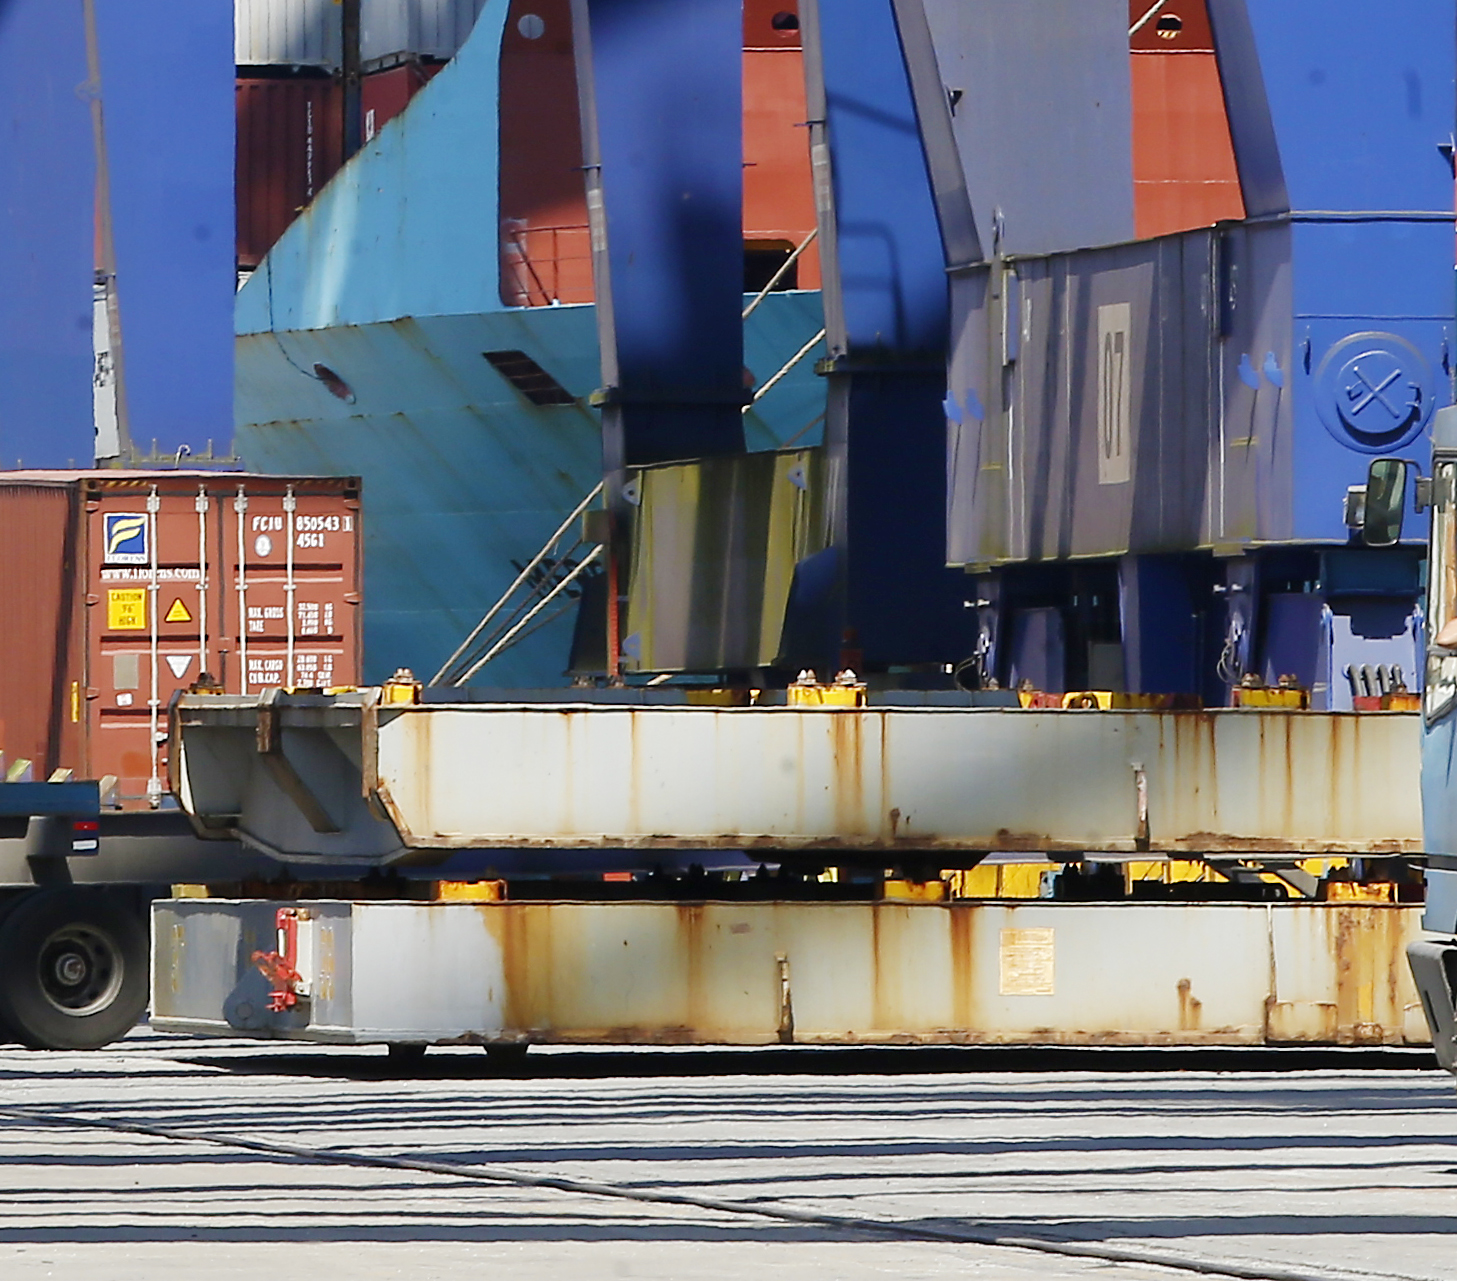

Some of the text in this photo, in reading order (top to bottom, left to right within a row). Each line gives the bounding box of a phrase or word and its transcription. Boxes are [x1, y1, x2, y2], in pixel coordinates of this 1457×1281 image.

[1104, 331, 1125, 459] 07
[252, 515, 283, 531] FCIU
[296, 515, 340, 532] 850543
[296, 533, 325, 548] 45G1
[111, 592, 143, 601] CAUTION
